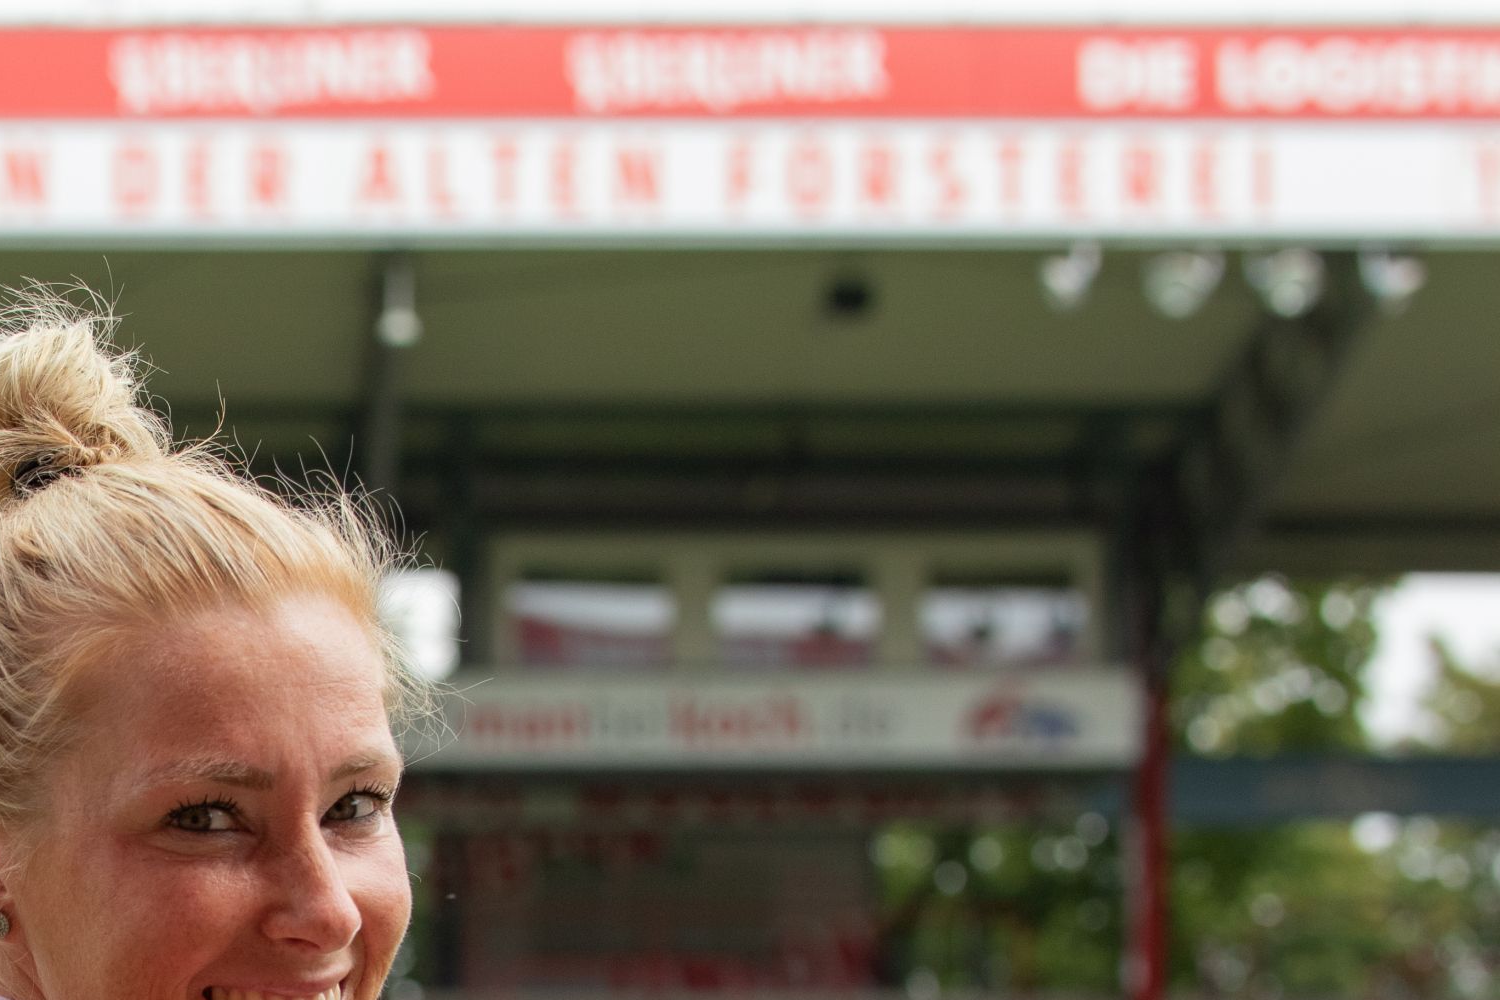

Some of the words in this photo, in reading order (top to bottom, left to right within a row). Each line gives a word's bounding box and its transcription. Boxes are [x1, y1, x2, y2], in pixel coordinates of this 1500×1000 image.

[1076, 37, 1197, 112] DIE
[108, 134, 292, 224] DER
[350, 134, 662, 224] ALTEN
